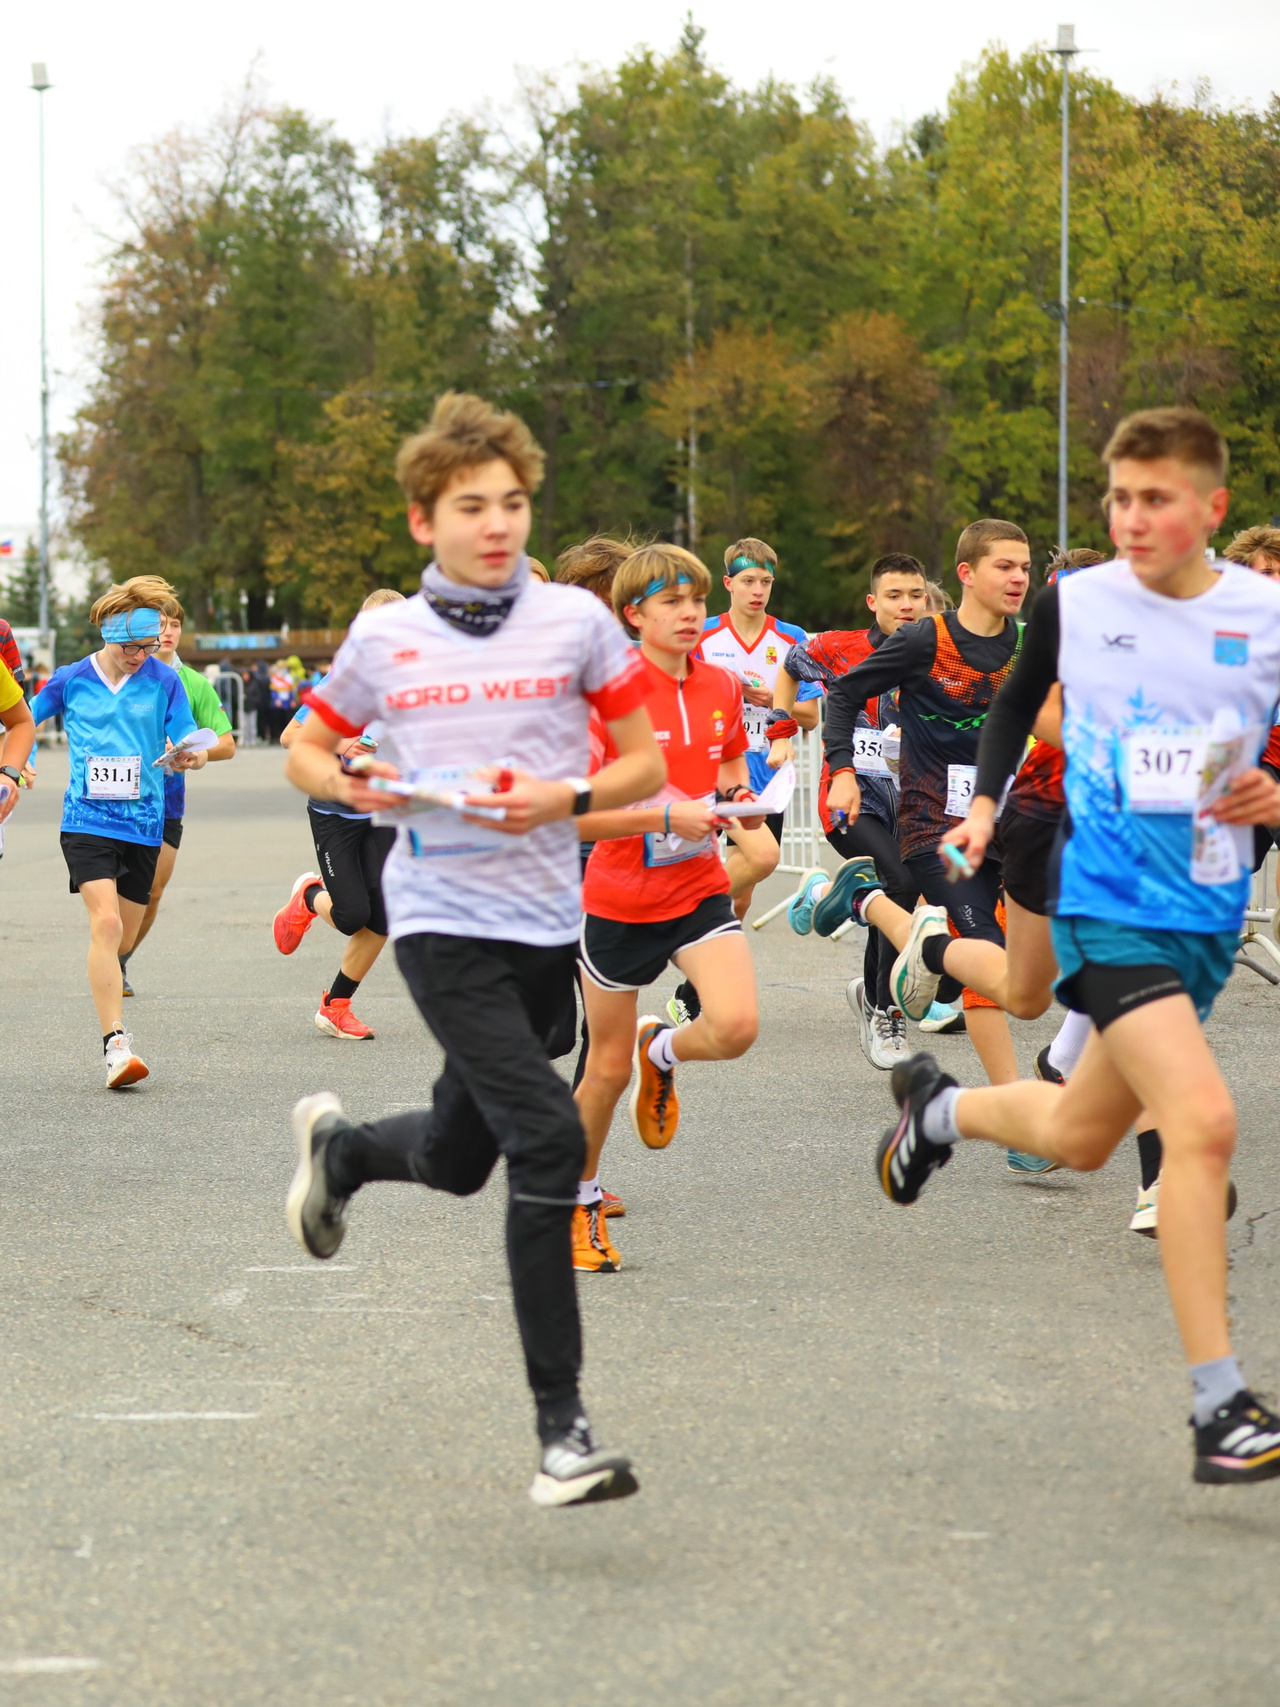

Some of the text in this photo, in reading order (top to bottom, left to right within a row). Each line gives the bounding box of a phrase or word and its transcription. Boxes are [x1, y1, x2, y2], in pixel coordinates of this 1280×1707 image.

[386, 675, 572, 710] NORD WEST
[91, 767, 131, 782] 331.1
